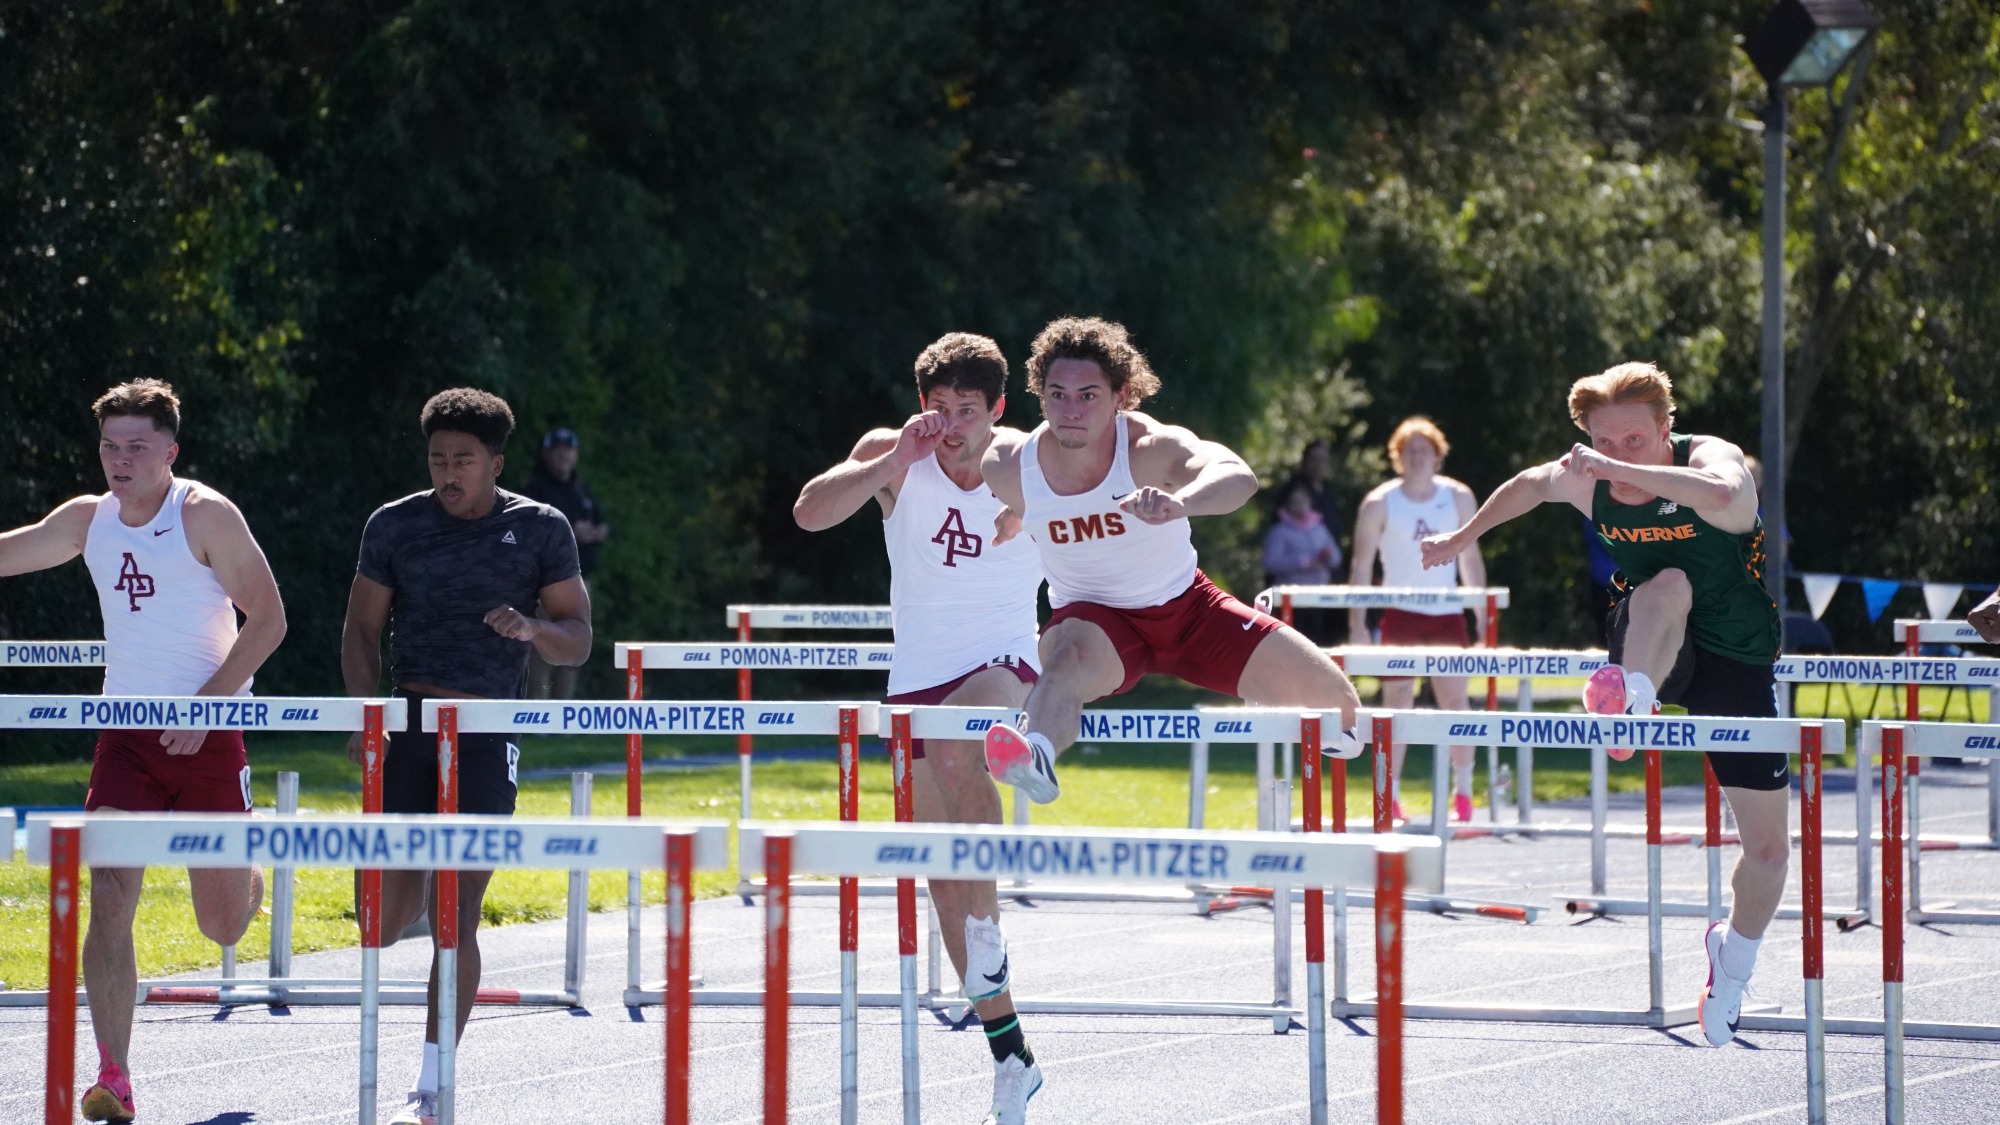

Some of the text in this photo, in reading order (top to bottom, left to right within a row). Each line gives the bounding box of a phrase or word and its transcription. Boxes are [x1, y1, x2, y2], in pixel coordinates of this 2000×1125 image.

[931, 506, 983, 568] AP
[1048, 512, 1126, 544] CMS
[114, 552, 156, 612] AP
[7, 645, 106, 664] POMONA-PI
[683, 652, 711, 662] GILL
[720, 648, 858, 667] POMONA-PITZER
[1386, 656, 1608, 675] GILL POMONA-PITZER GIL
[1773, 660, 2000, 681] ILL POMONA-PITZER GILL
[29, 701, 320, 727] GILL POMONA-PITZER GILL
[513, 706, 796, 730] GILL POMONA-PITZER GILL
[965, 714, 1254, 739] GIL NA-PITZER GILL
[1448, 719, 1751, 747] GILL POMONA-PITZER GILL
[1964, 736, 2000, 749] GIL
[168, 826, 599, 863] GILL POMONA-PITZER GILL
[876, 838, 1306, 878] GILL POMONA-PITZER GILL
